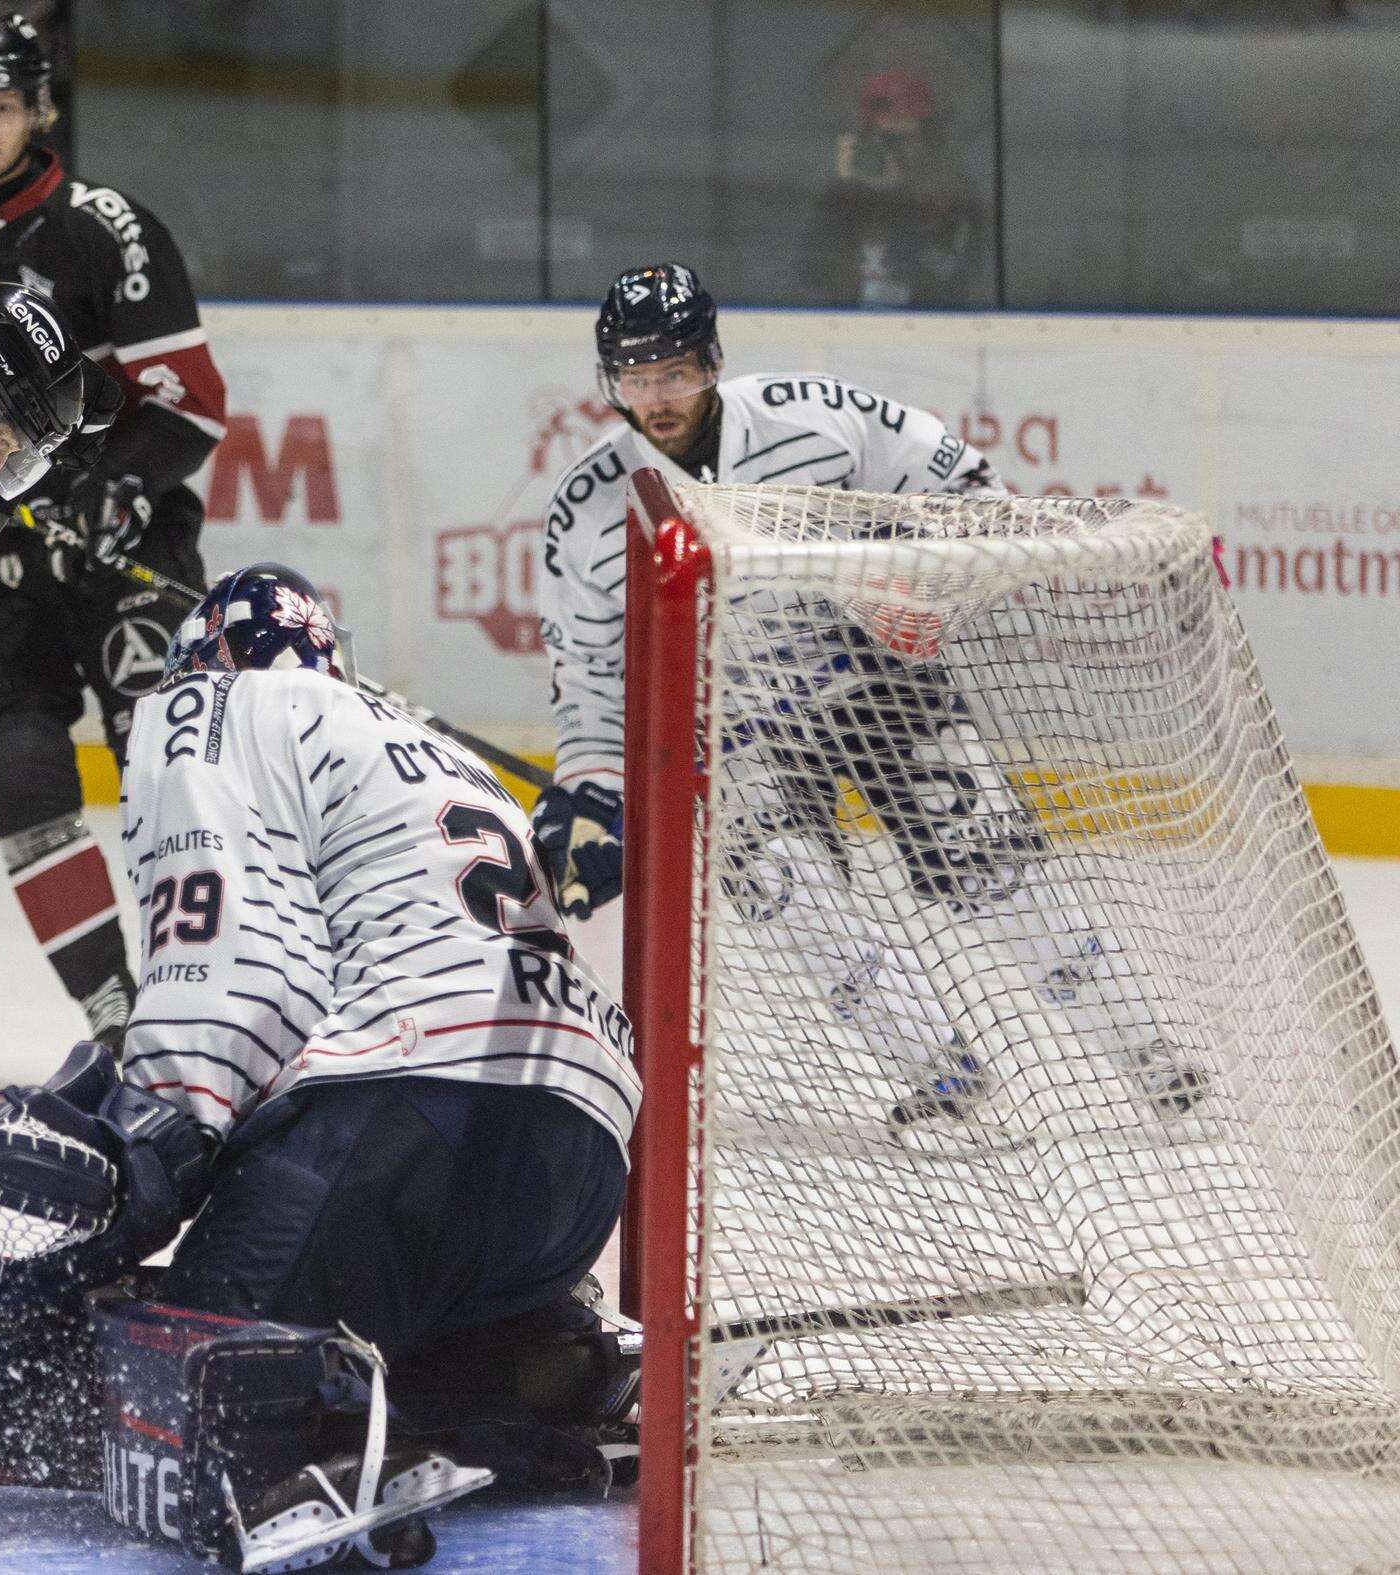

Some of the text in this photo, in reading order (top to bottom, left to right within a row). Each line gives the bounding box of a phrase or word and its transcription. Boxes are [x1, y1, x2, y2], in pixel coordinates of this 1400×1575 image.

[10, 302, 61, 364] engie
[762, 377, 906, 434] anjou
[154, 829, 224, 864] EALITES
[148, 868, 226, 961] 29
